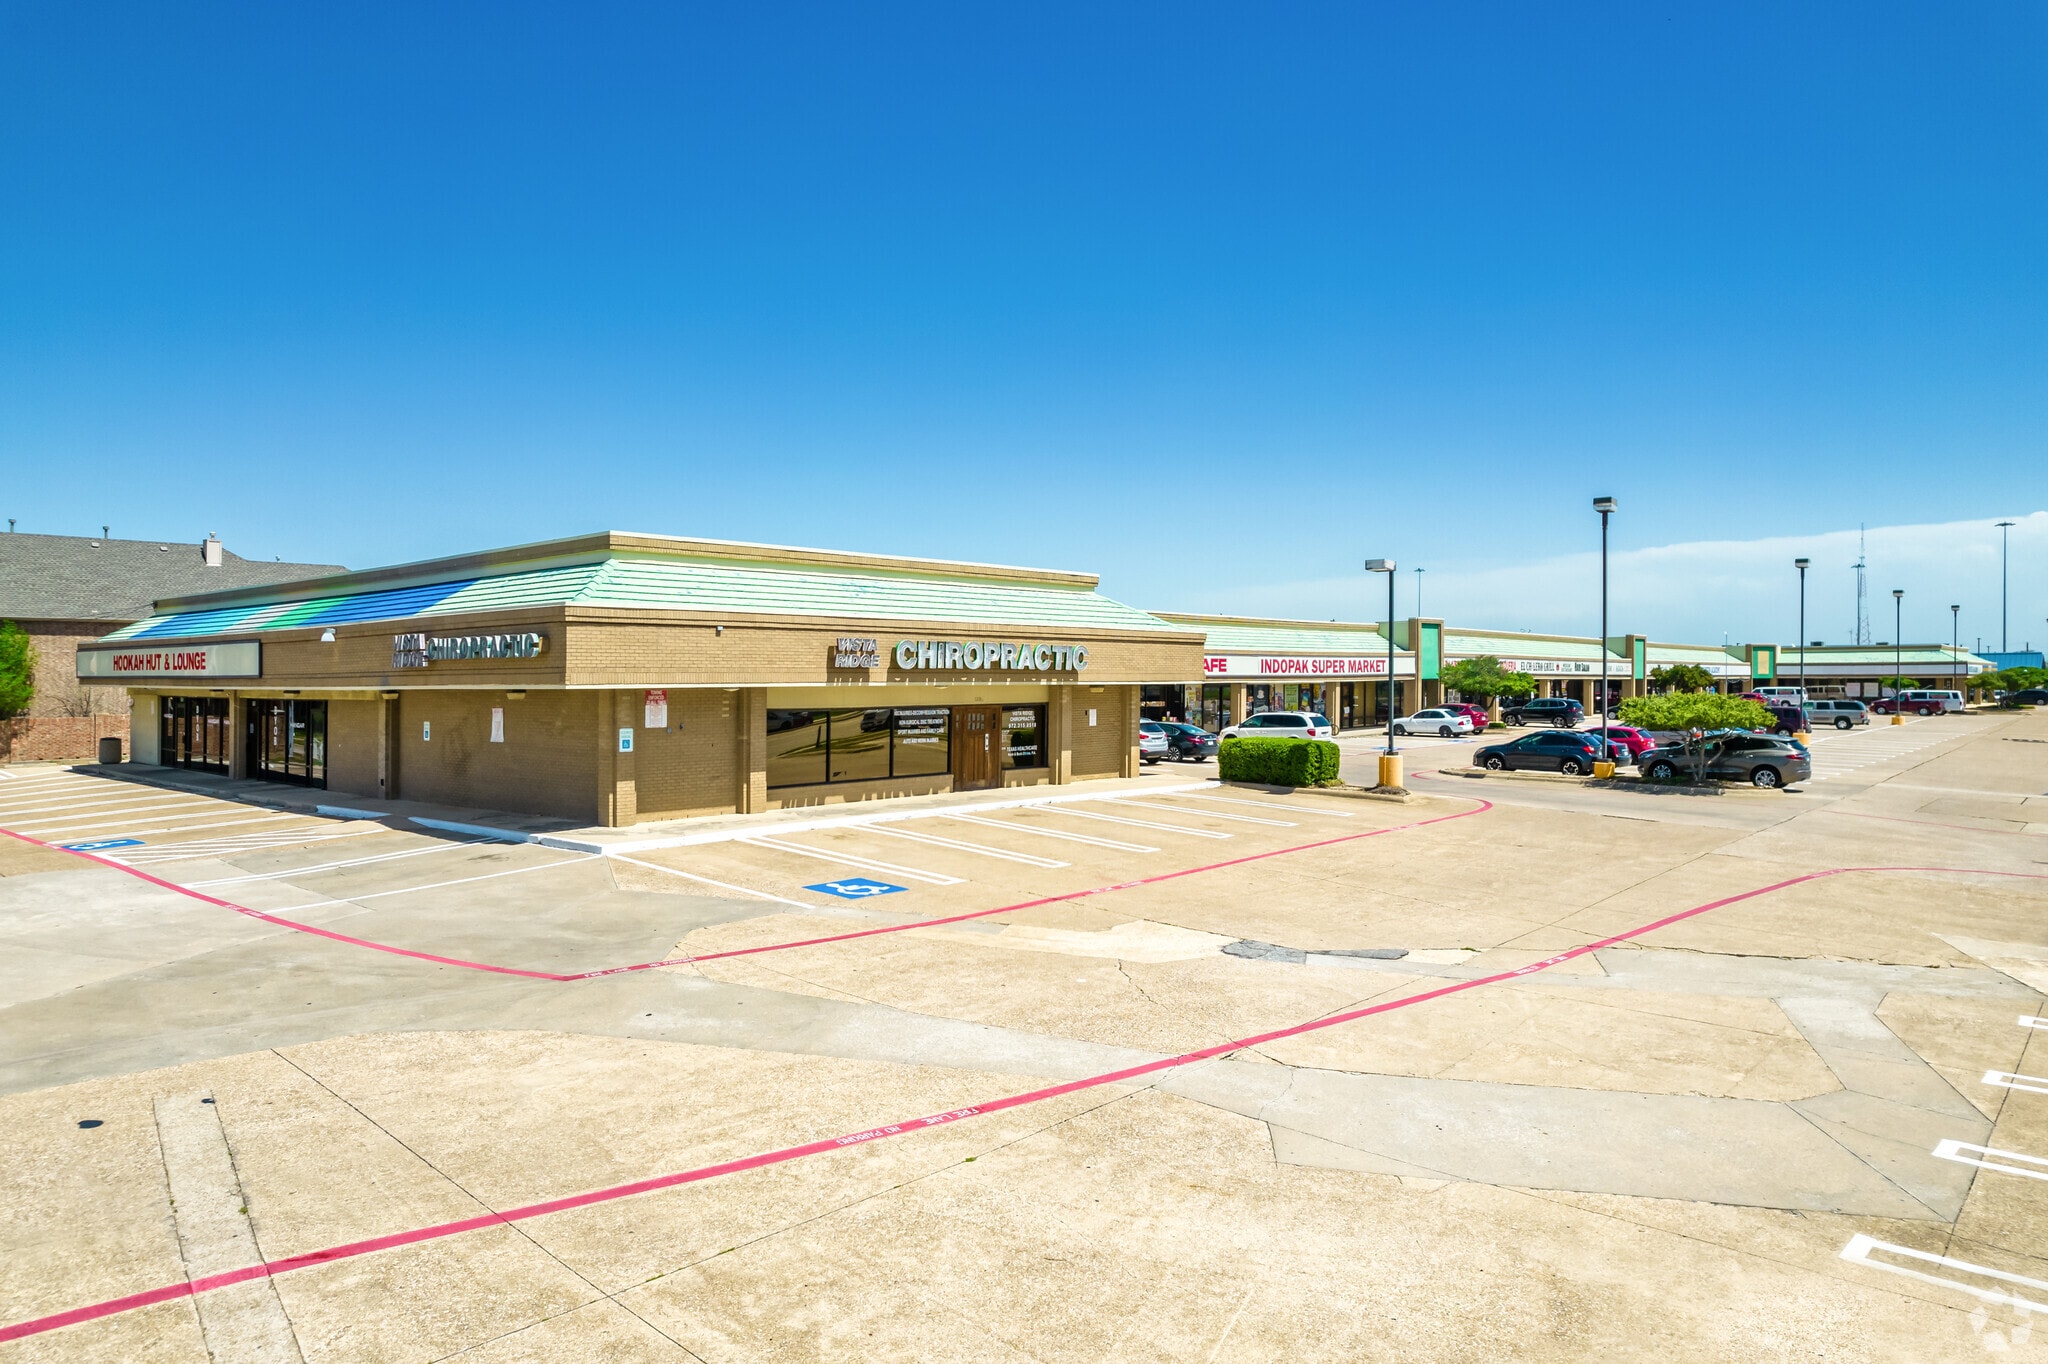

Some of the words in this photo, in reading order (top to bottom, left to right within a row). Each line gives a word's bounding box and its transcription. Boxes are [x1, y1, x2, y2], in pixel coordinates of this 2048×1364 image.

[427, 632, 541, 660] CHIROPRACTIC
[836, 637, 878, 652] VISTA
[113, 654, 145, 671] HOOKAH
[145, 653, 162, 671] HUT
[164, 653, 170, 671] &
[172, 651, 206, 670] LOUNGE
[834, 653, 880, 668] RIDGE
[895, 639, 1089, 671] CHIROPRACTIC
[1260, 658, 1309, 674] INDOPAK
[1311, 659, 1345, 674] SUPER
[1347, 659, 1386, 673] MARKET
[920, 1113, 953, 1125] LANE
[952, 1108, 980, 1119] FIRE
[884, 1125, 903, 1135] NO
[835, 1130, 884, 1146] PARKING
